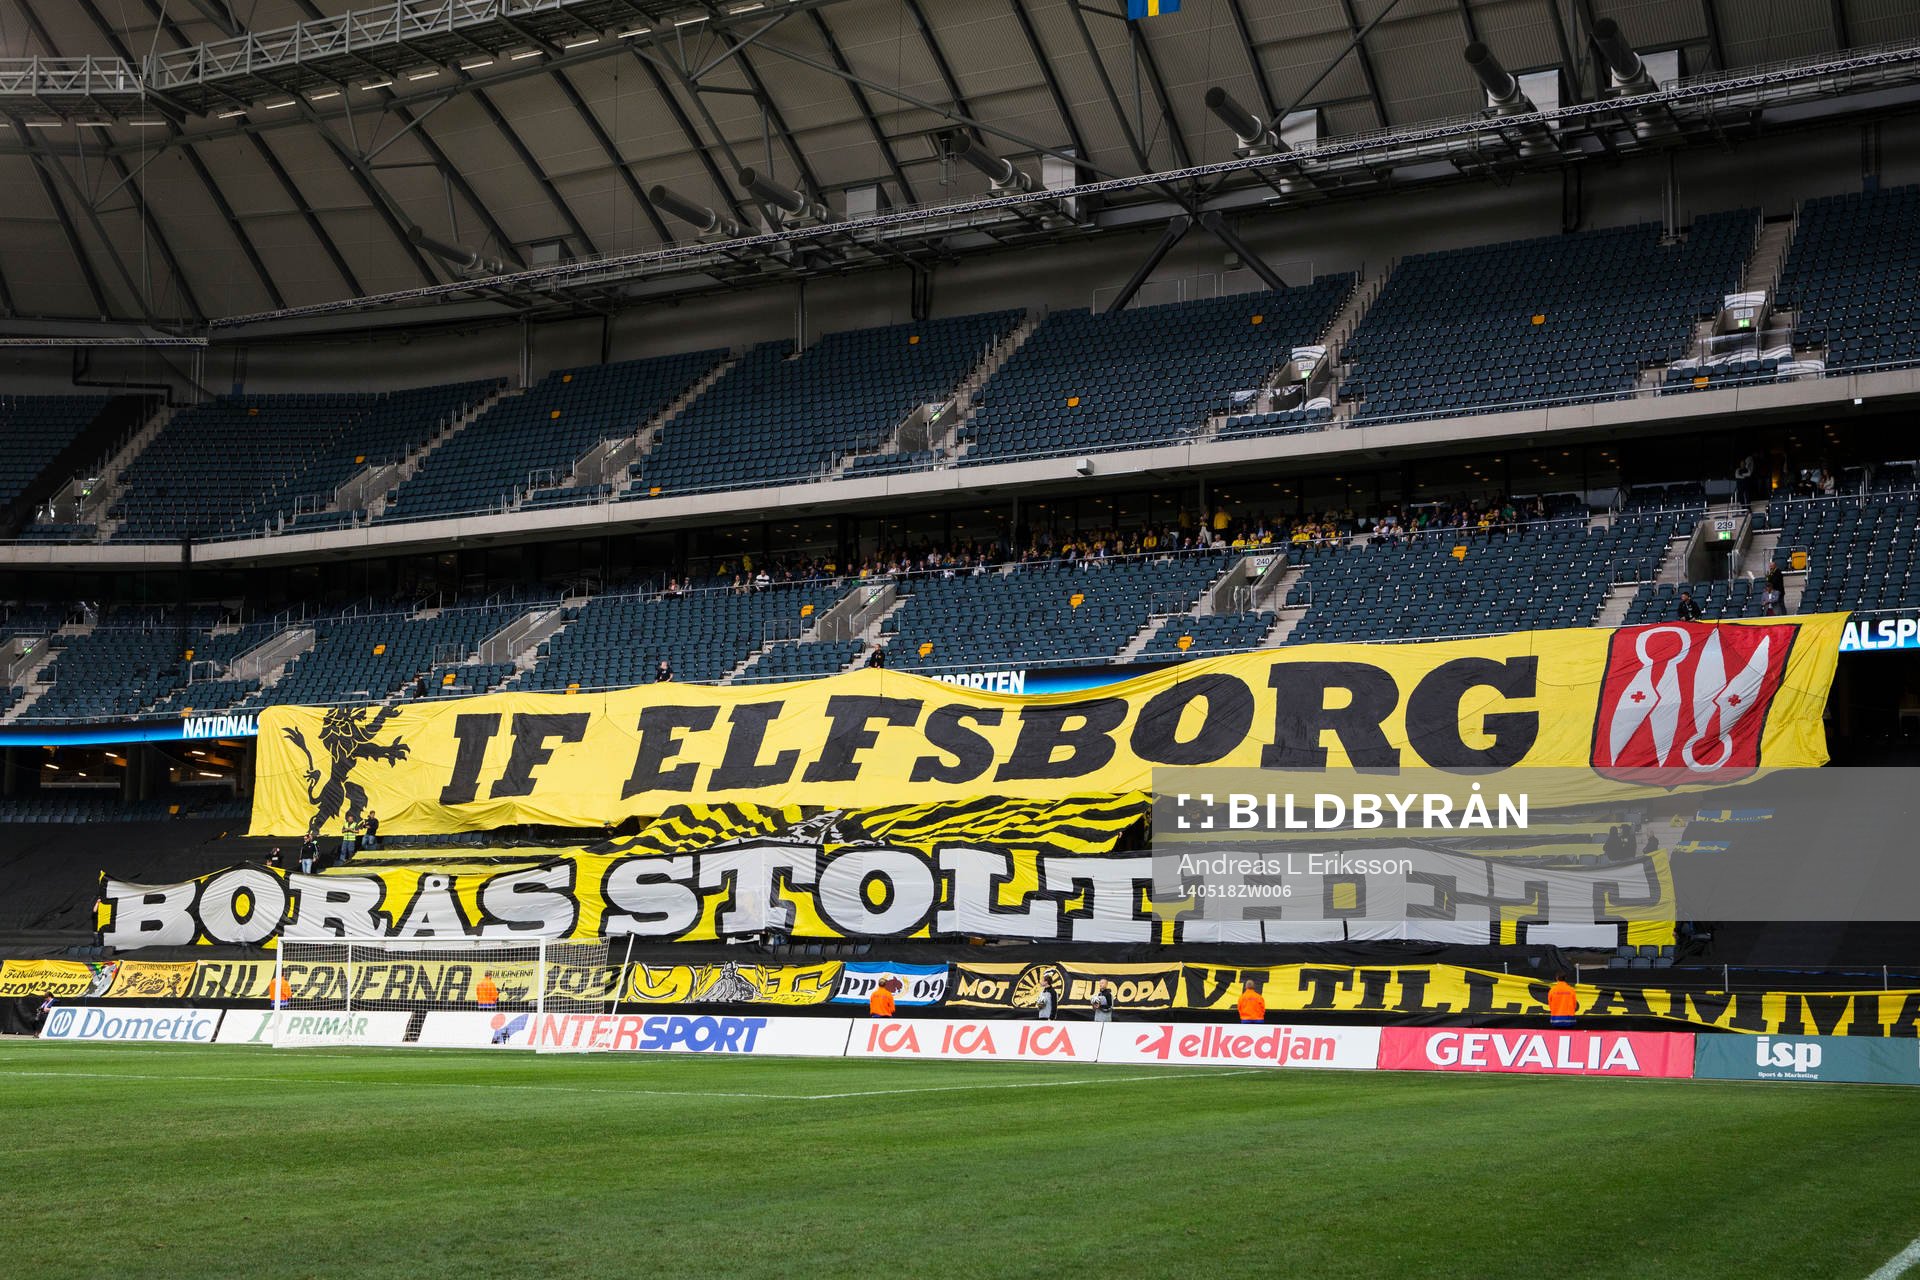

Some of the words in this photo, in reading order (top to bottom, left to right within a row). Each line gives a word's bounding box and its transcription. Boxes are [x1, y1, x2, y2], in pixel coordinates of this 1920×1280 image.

[1717, 521, 1733, 530] 239
[1256, 558, 1270, 566] 240
[1839, 619, 1920, 650] ALSP
[931, 670, 1026, 695] ORTEN
[183, 714, 260, 738] NATIONAL
[440, 711, 591, 805] IF
[621, 655, 1540, 800] ELFSBORG
[102, 863, 578, 950] BORÅS
[602, 845, 1655, 952] STOLTHET
[843, 975, 877, 998] PP
[913, 979, 946, 999] 09
[956, 975, 1010, 1000] MOT
[79, 1010, 212, 1040] Dometic
[286, 1012, 369, 1036] PRIMÄR
[527, 1013, 767, 1051] INTERSPORT
[866, 1023, 921, 1053] ICA
[941, 1024, 997, 1054] ICA
[1018, 1025, 1076, 1057] ICA
[1178, 1025, 1336, 1066] elkedjan
[1425, 1032, 1640, 1072] GEVALIA
[1756, 1036, 1822, 1072] isp
[1784, 1071, 1819, 1079] Marketing
